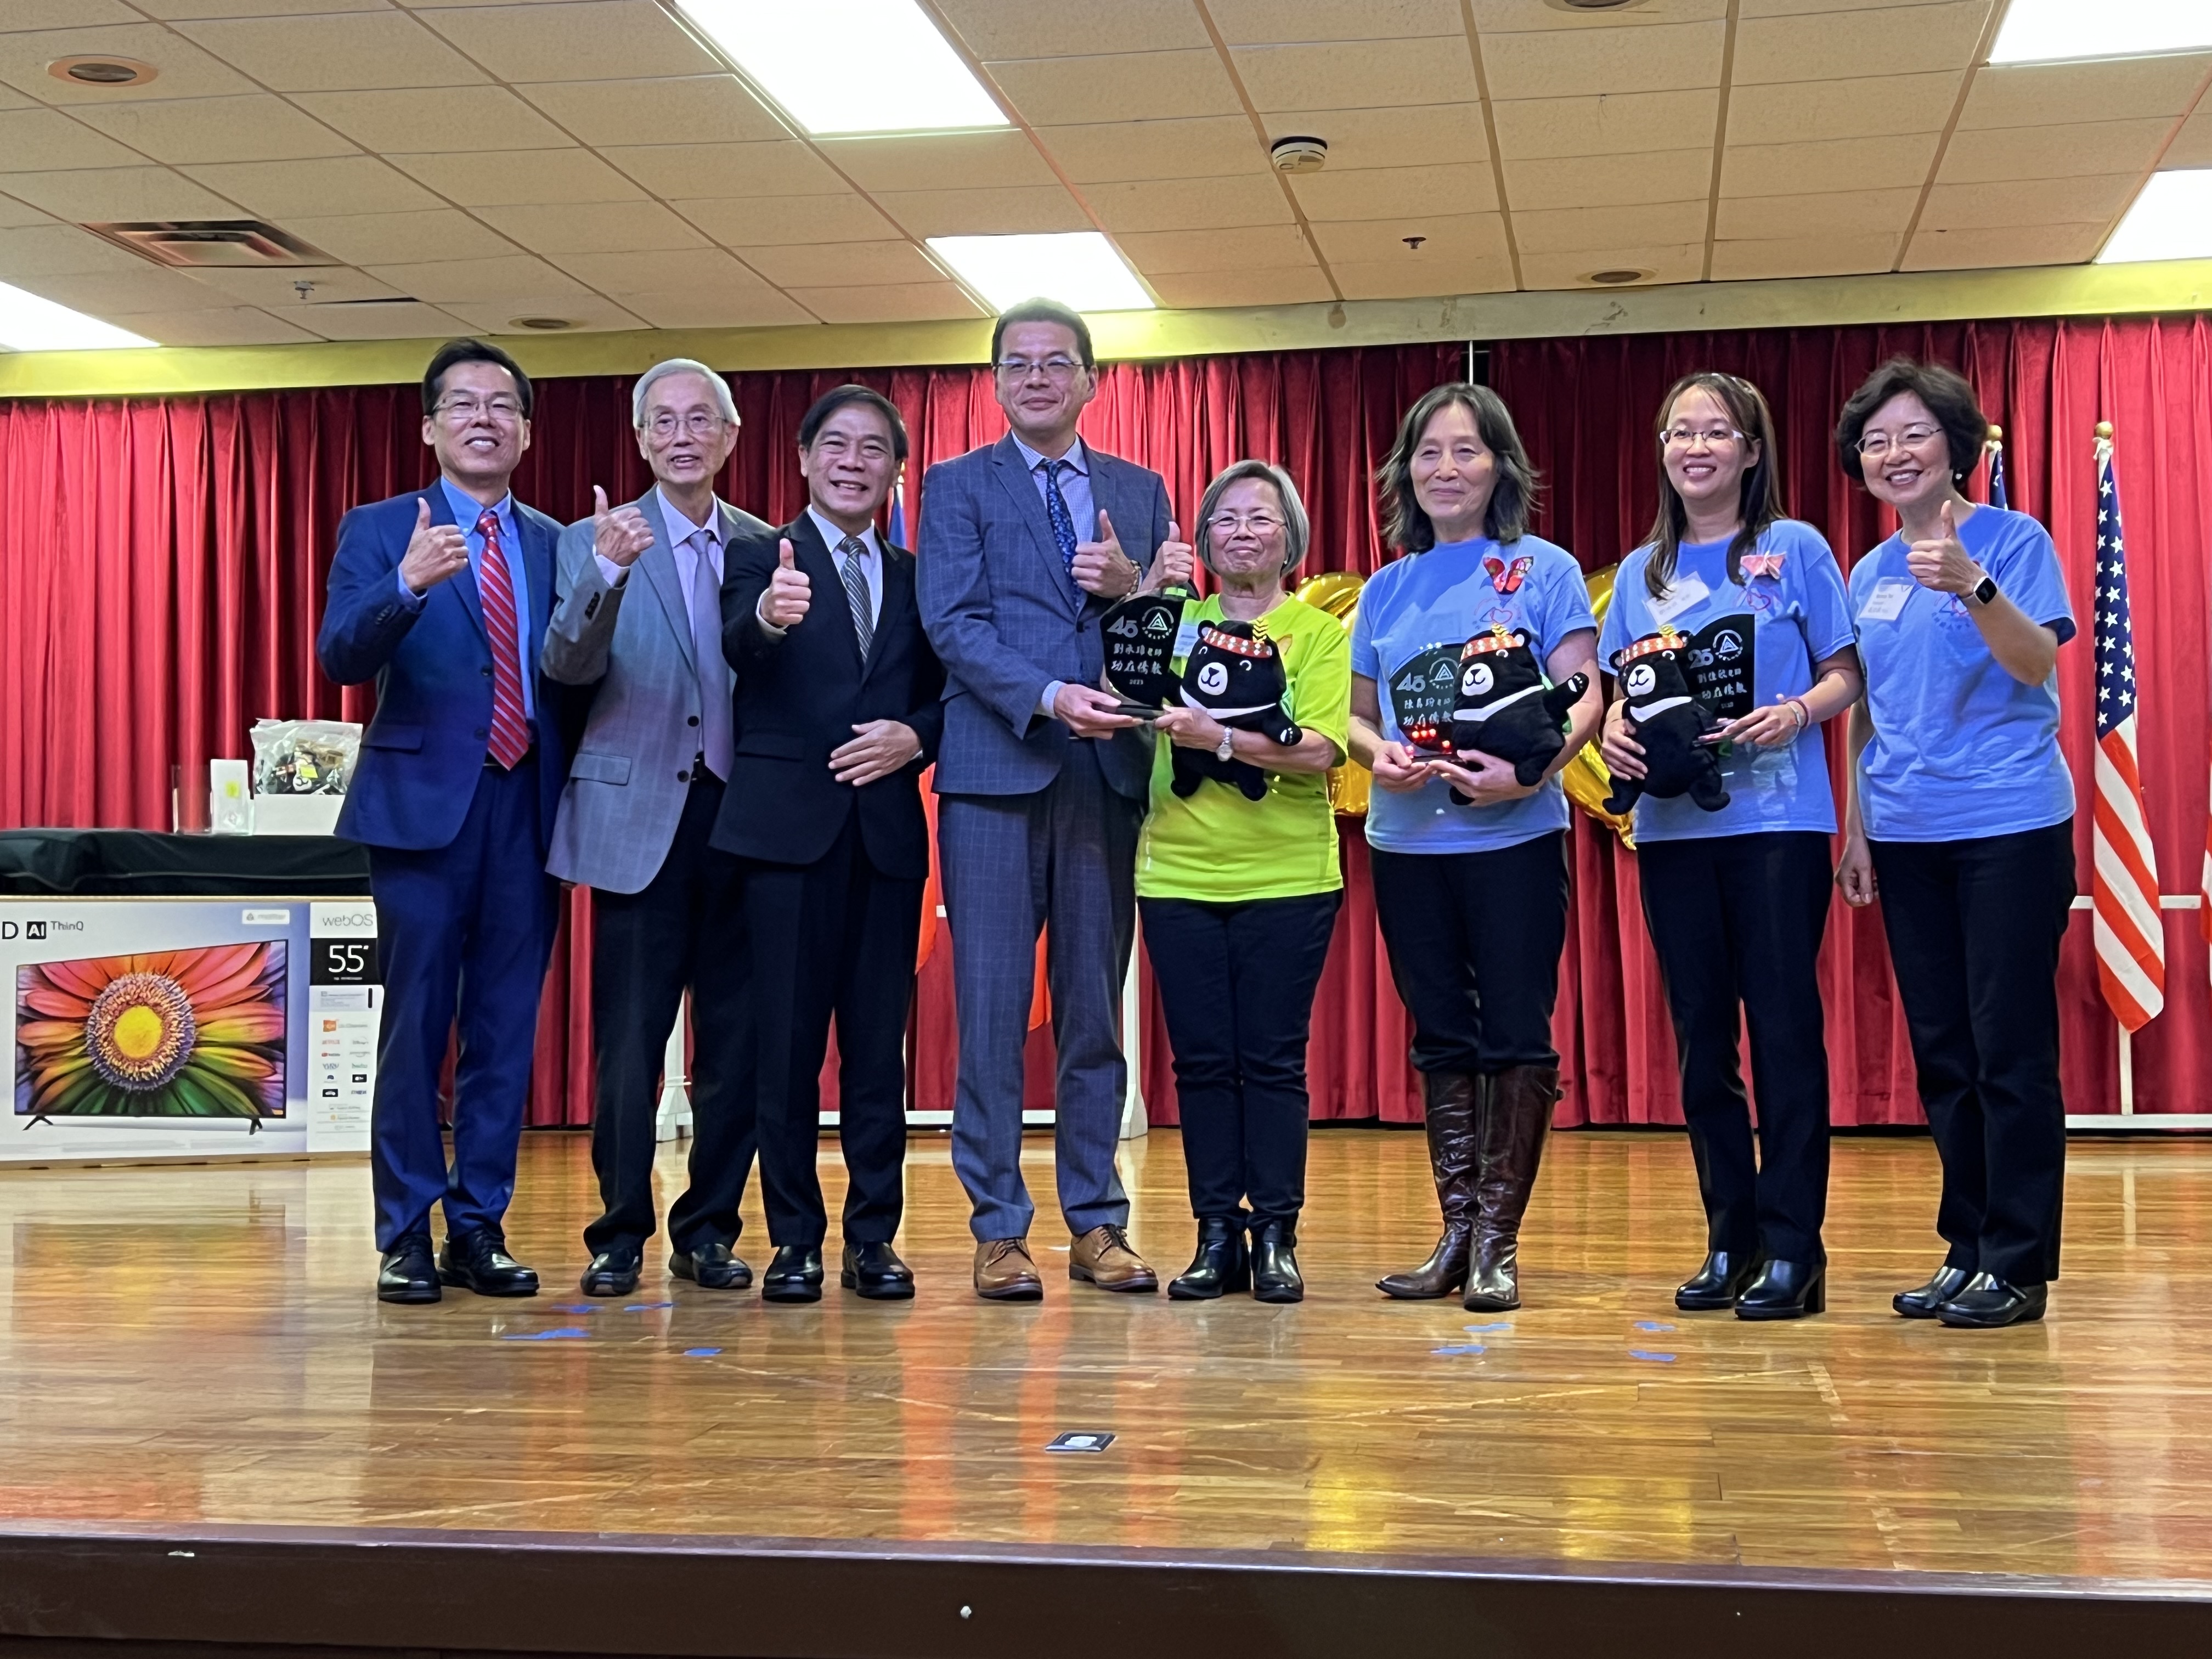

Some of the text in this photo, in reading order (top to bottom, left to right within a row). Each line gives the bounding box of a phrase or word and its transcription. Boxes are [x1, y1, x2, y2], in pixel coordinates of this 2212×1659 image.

[1107, 615, 1138, 638] 45
[1396, 672, 1426, 692] 45
[323, 914, 373, 926] webOS
[2, 921, 83, 939] D AI ThinQ
